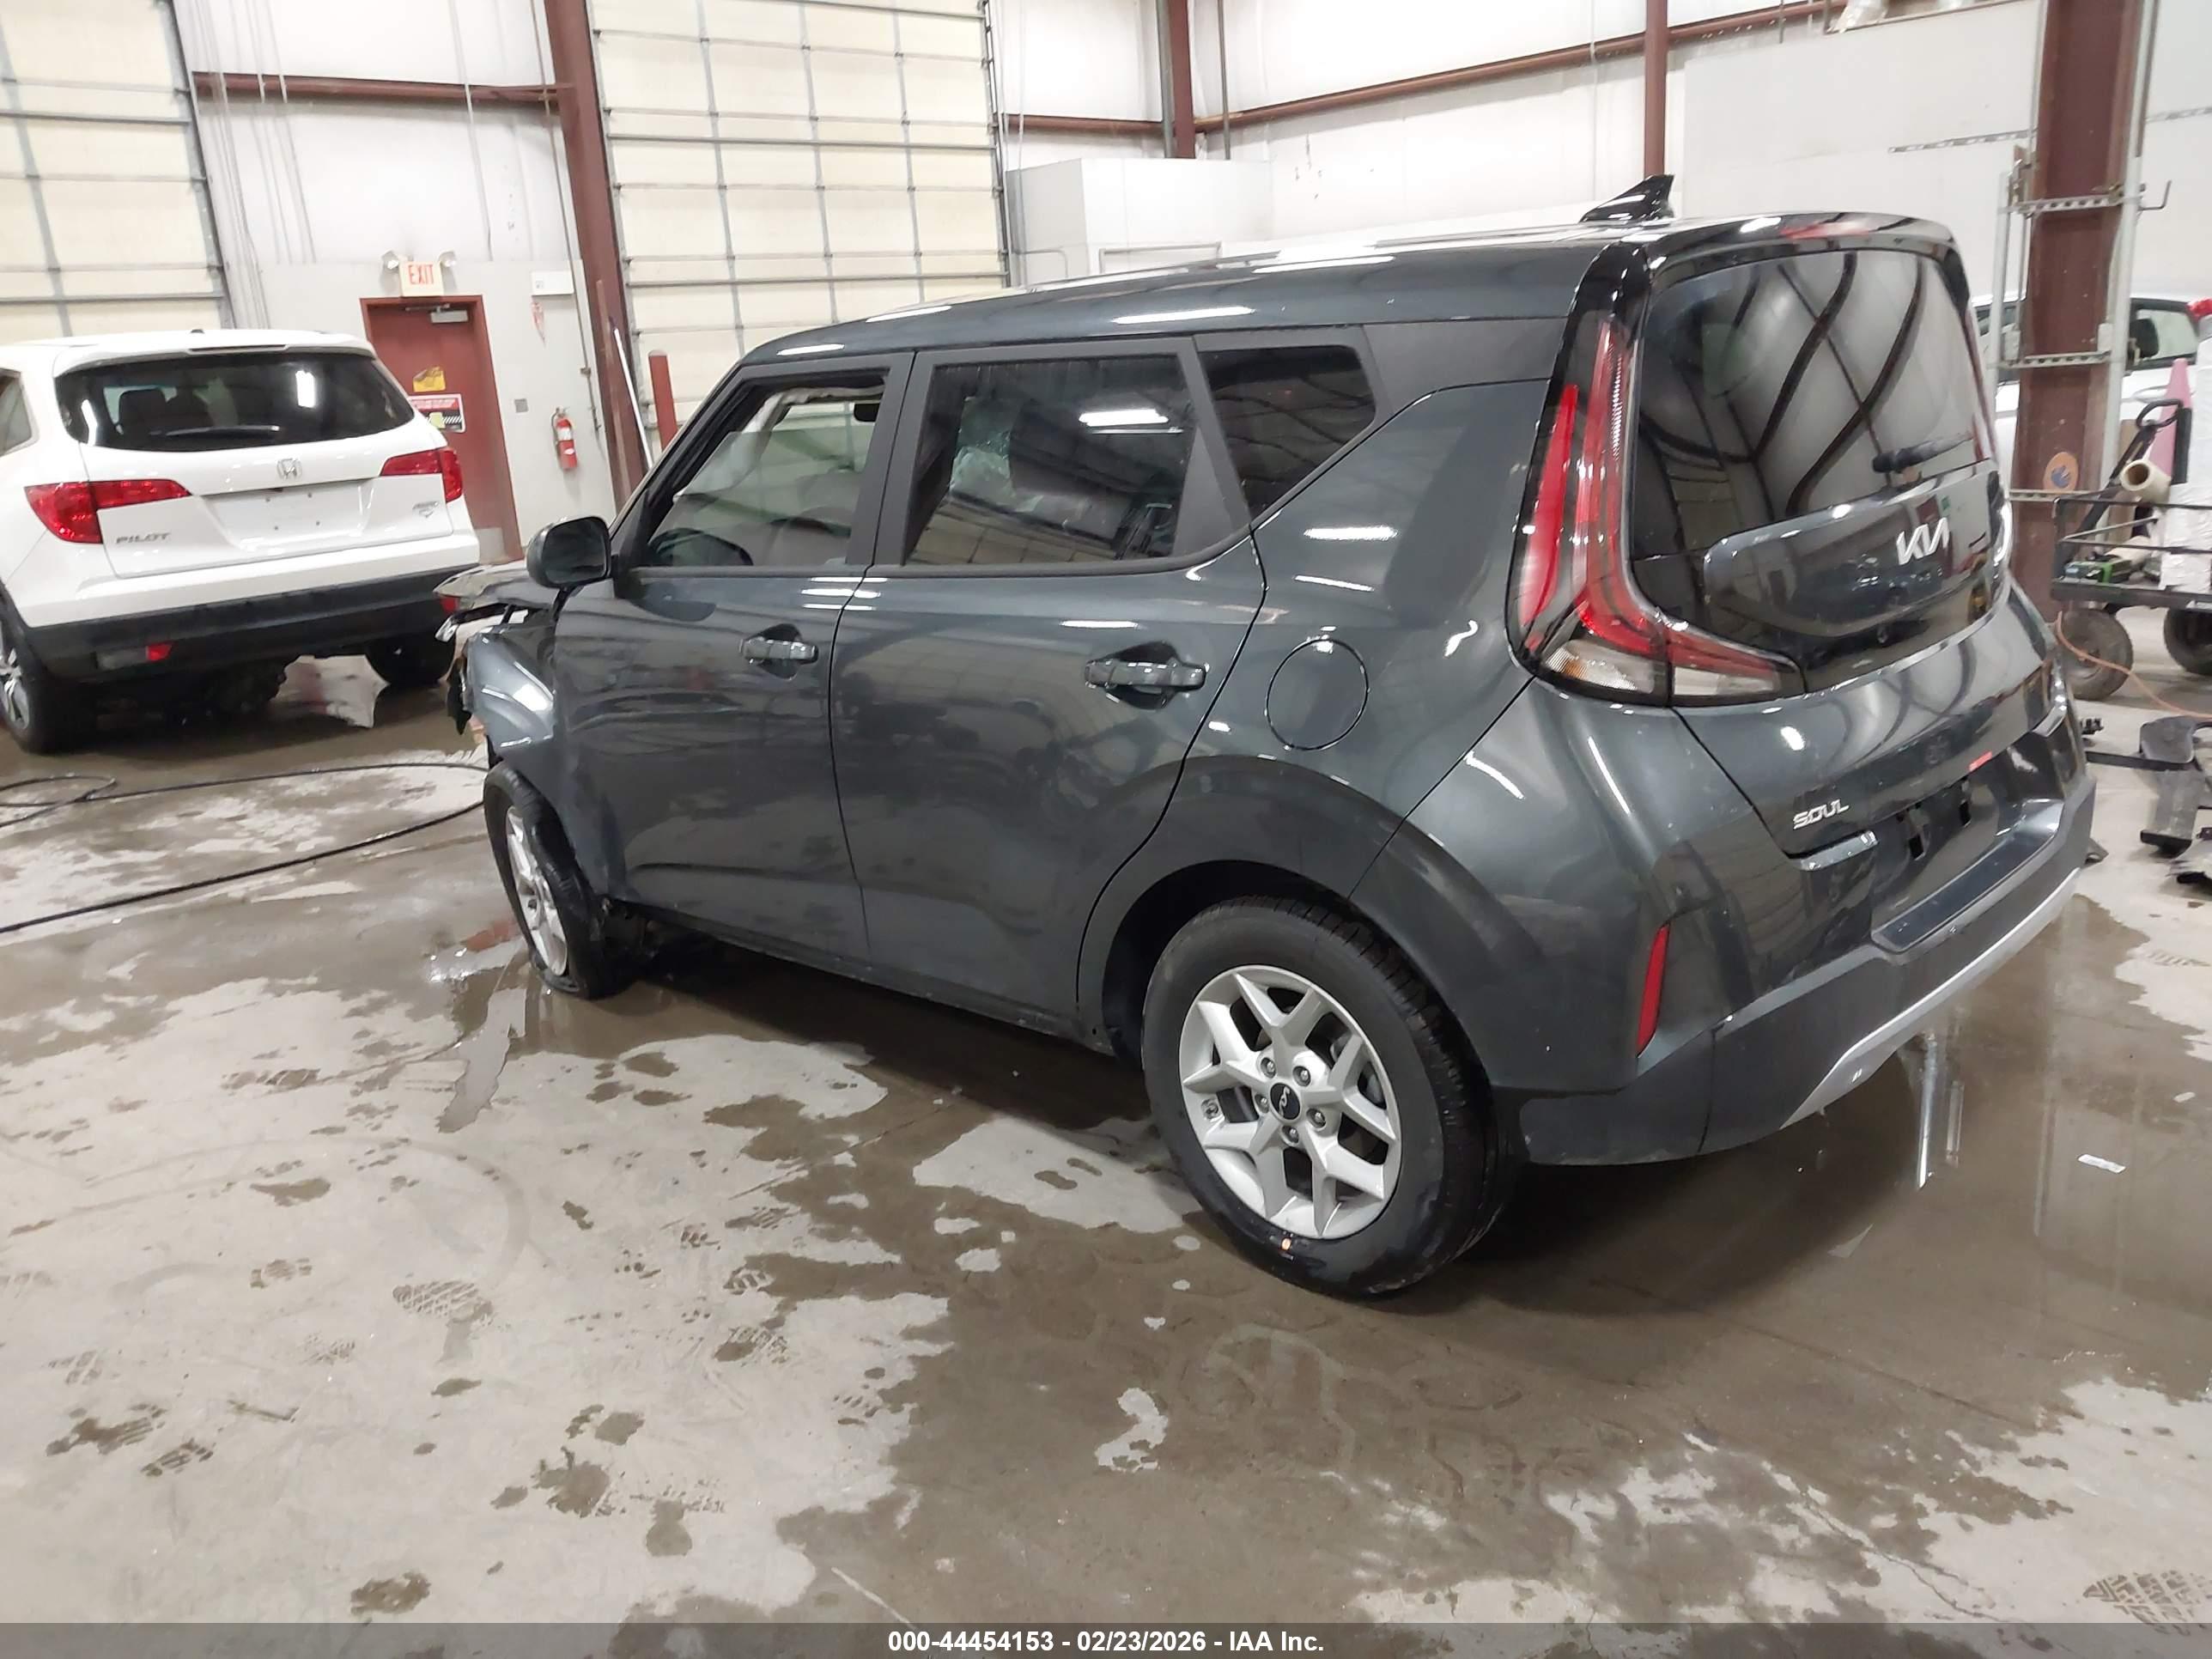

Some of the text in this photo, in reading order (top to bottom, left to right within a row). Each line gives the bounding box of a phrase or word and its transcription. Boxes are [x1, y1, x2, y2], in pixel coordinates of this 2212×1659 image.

[408, 264, 434, 285] EXIT
[116, 532, 171, 544] PILOT
[1896, 517, 1950, 566] KIA
[1792, 799, 1850, 830] SOUL
